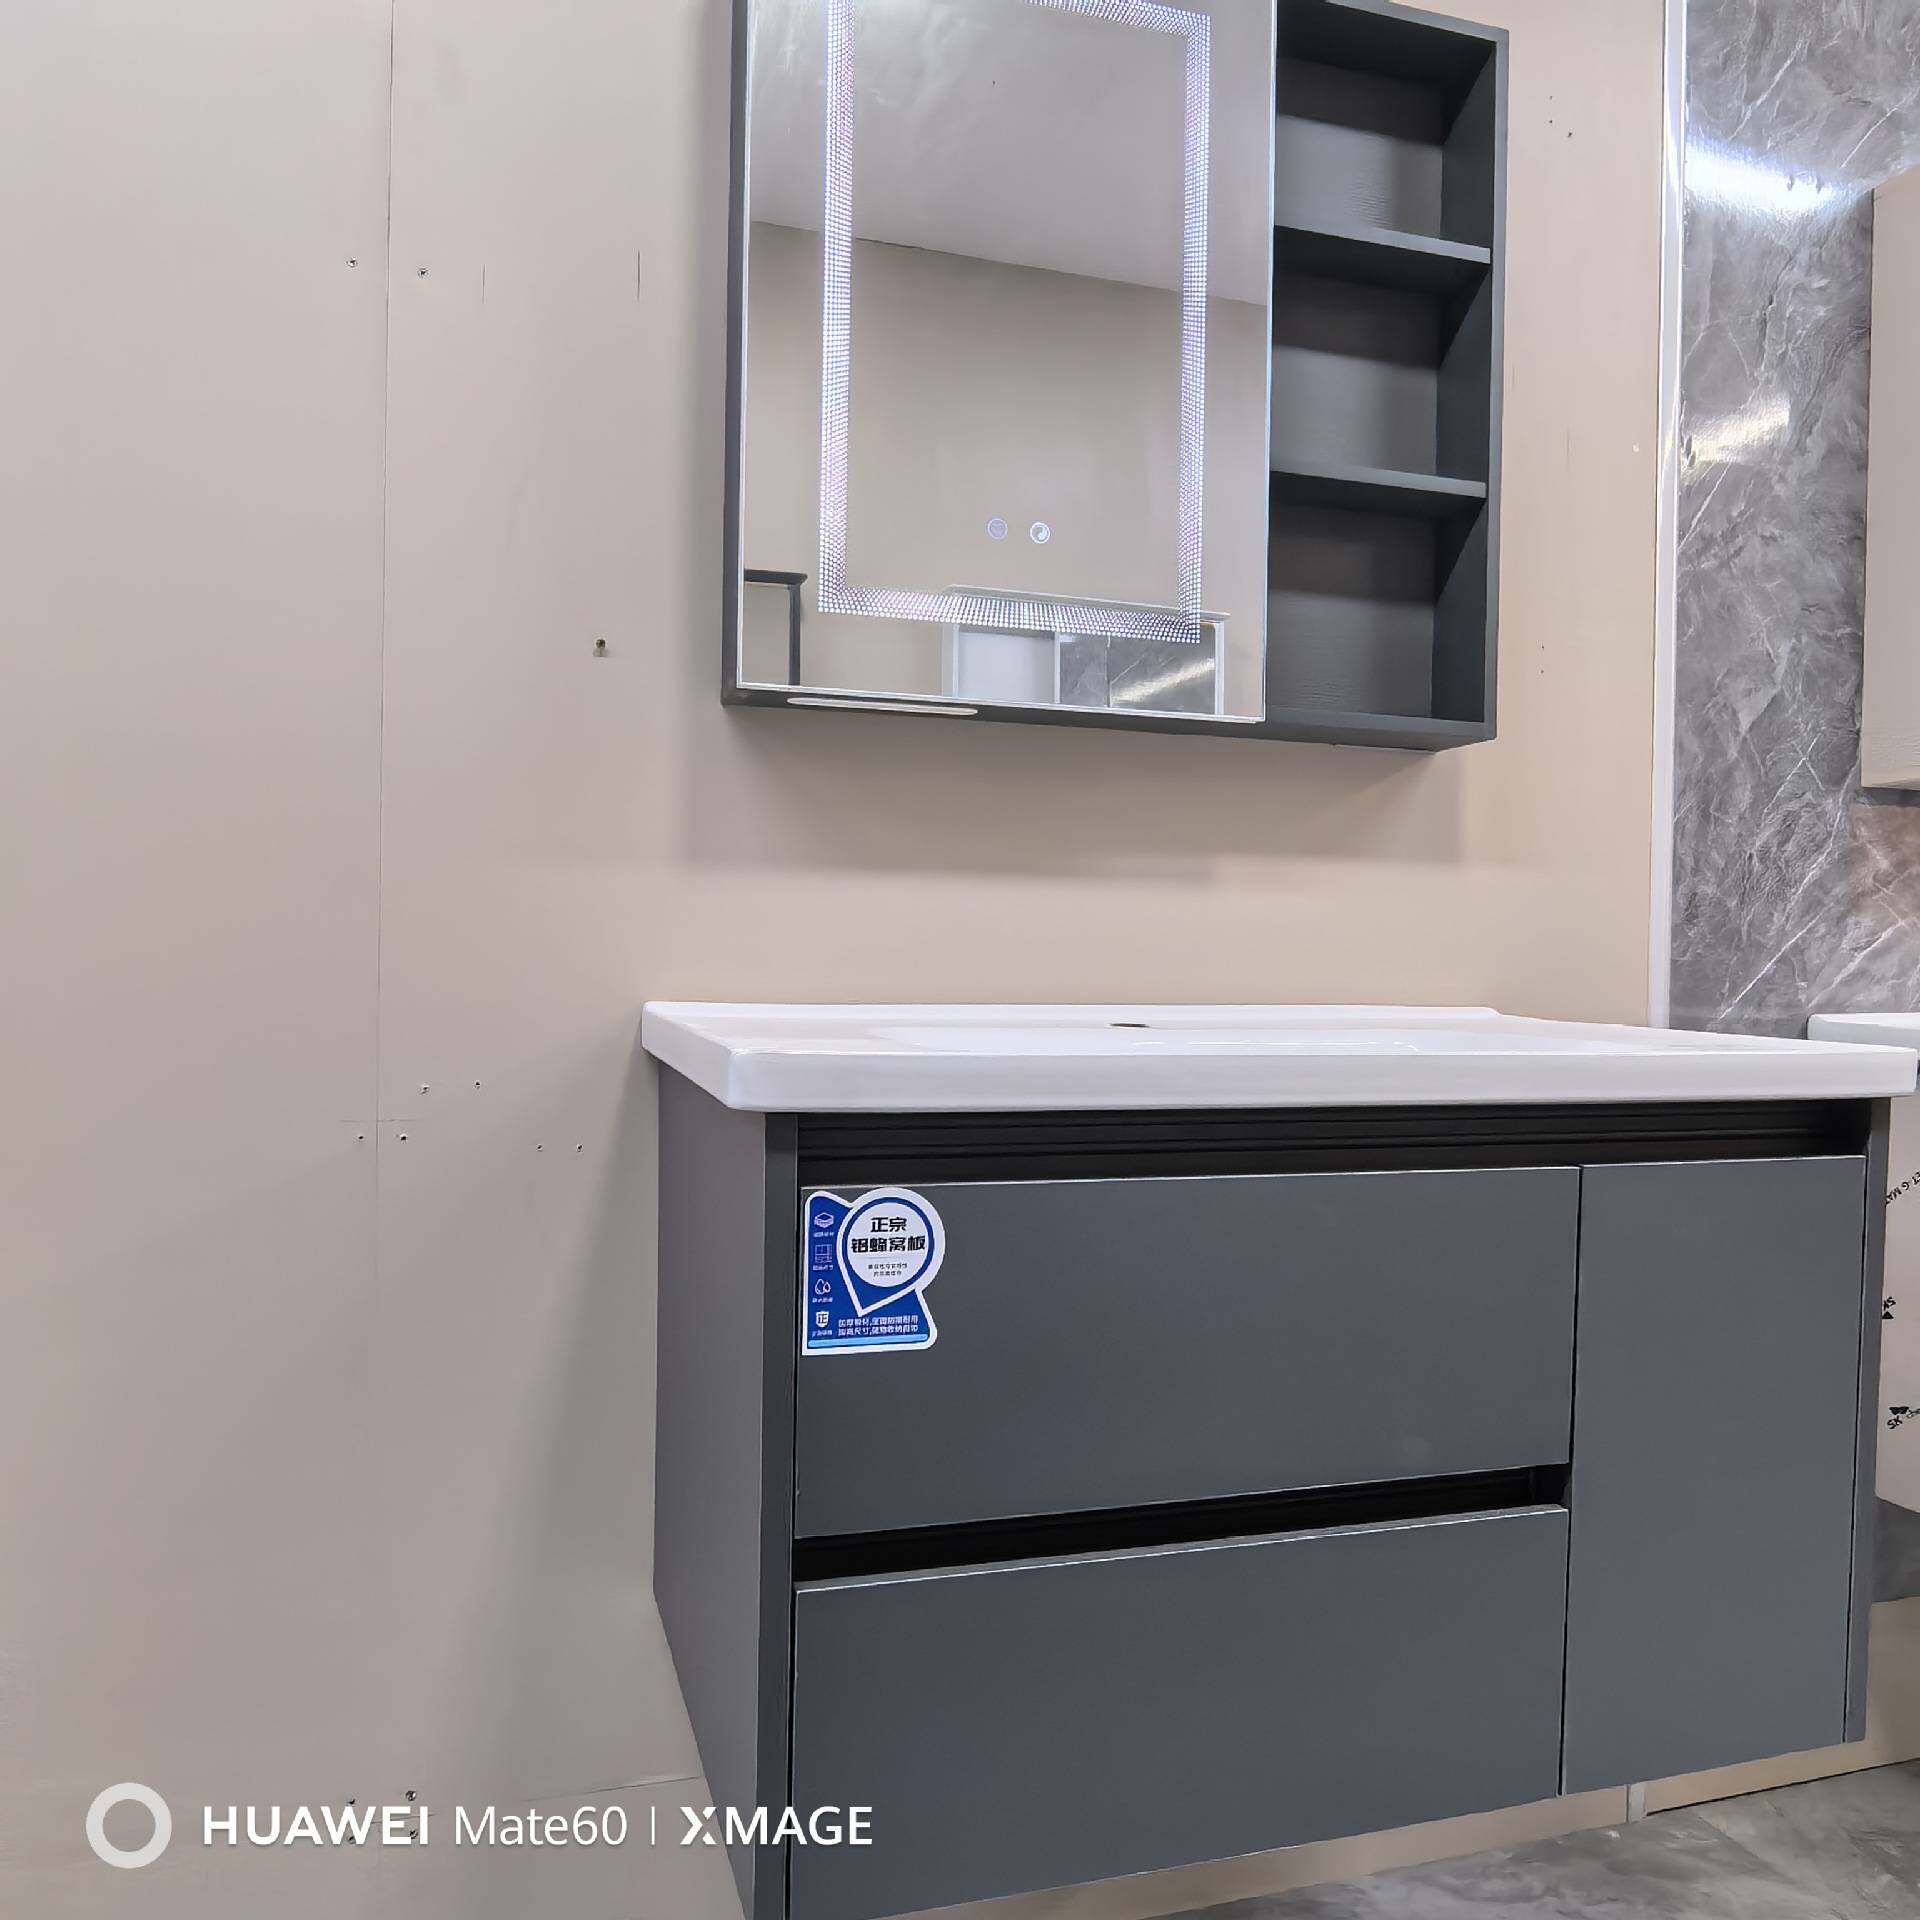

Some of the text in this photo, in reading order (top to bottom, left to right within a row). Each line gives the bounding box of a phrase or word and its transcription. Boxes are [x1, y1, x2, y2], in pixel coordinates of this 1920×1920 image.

[870, 1217, 907, 1233] 正宗
[851, 1235, 926, 1253] 铝蜂窝板
